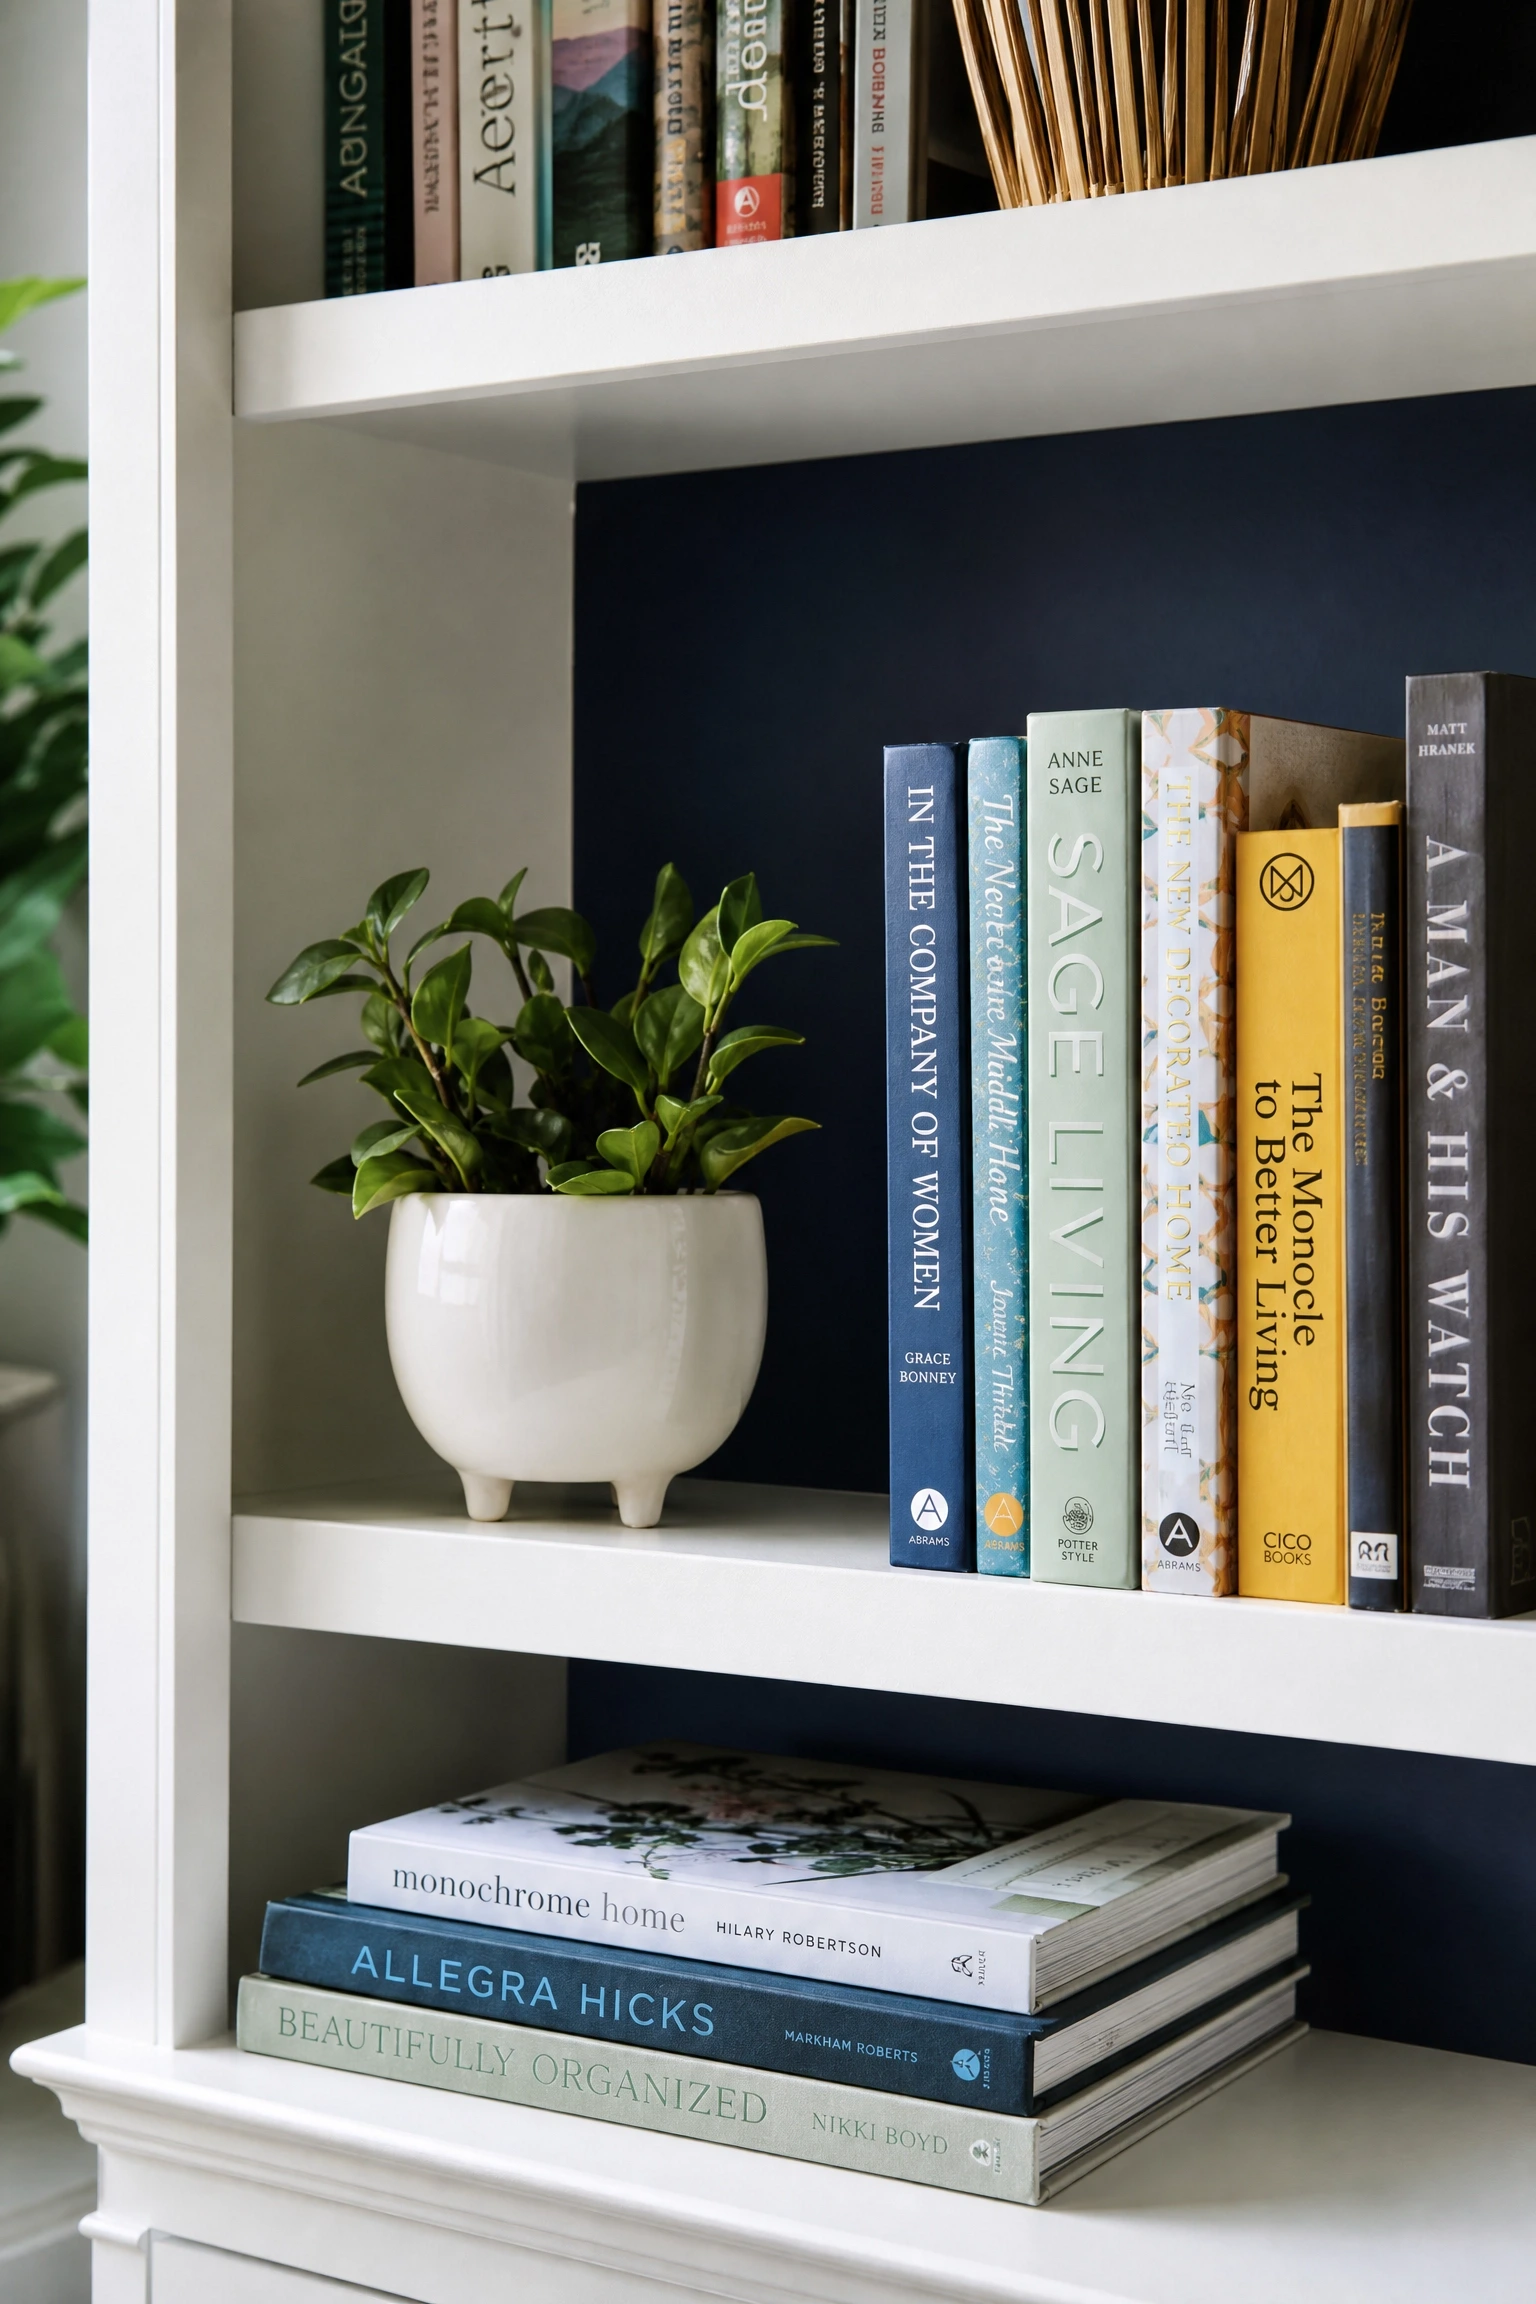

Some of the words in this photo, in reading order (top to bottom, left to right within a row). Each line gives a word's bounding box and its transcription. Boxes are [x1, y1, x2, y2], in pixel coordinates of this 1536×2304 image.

[1418, 742, 1476, 757] HRANEK
[1427, 723, 1467, 735] MATT
[1048, 750, 1103, 768] ANNE
[909, 785, 936, 823] IN
[1049, 777, 1102, 794] SAGE
[983, 795, 1015, 851] The
[1167, 775, 1192, 847] THE
[908, 836, 936, 910] THE
[1426, 835, 1469, 873] A
[1167, 860, 1192, 935] NEW
[1048, 832, 1105, 1078] SAGE
[1426, 900, 1469, 1032] MAN
[909, 923, 938, 1098] COMPANY
[1167, 948, 1192, 1168] DECORATED
[1255, 1080, 1282, 1120] to
[1426, 1063, 1469, 1101] &
[910, 1111, 939, 1158] OF
[1292, 1072, 1322, 1153] The
[1255, 1136, 1287, 1265] Better
[1427, 1131, 1470, 1240] HIS
[911, 1171, 940, 1311] WOMEN
[1166, 1183, 1193, 1301] HOME
[1292, 1167, 1324, 1346] Monocle
[1048, 1121, 1107, 1453] LIVING
[905, 1351, 951, 1366] GRACE
[1249, 1278, 1288, 1412] Living
[899, 1370, 956, 1386] BONNEY
[1427, 1270, 1471, 1489] WATCH
[908, 1535, 950, 1547] ABRAMS
[983, 1540, 1025, 1552] ABRAMS
[1058, 1538, 1098, 1551] POTTER
[1061, 1550, 1094, 1563] STYLE
[1263, 1532, 1312, 1550] CICO
[1264, 1551, 1312, 1566] BOOKS
[1157, 1560, 1201, 1572] ABRAMS
[392, 1867, 590, 1918] monochrome
[602, 1892, 686, 1933] home
[716, 1920, 775, 1942] HILARY
[782, 1929, 882, 1959] ROBERTSON
[351, 1945, 558, 2011] ALLEGRA
[580, 1982, 715, 2037] HICKS
[278, 2006, 515, 2078] BEAUTIFULLY
[532, 2052, 768, 2126] ORGANIZED
[784, 2029, 852, 2053] MARKHAM
[857, 2039, 919, 2064] ROBERTS
[811, 2112, 877, 2141] NIKKI
[885, 2124, 949, 2155] BOYD
